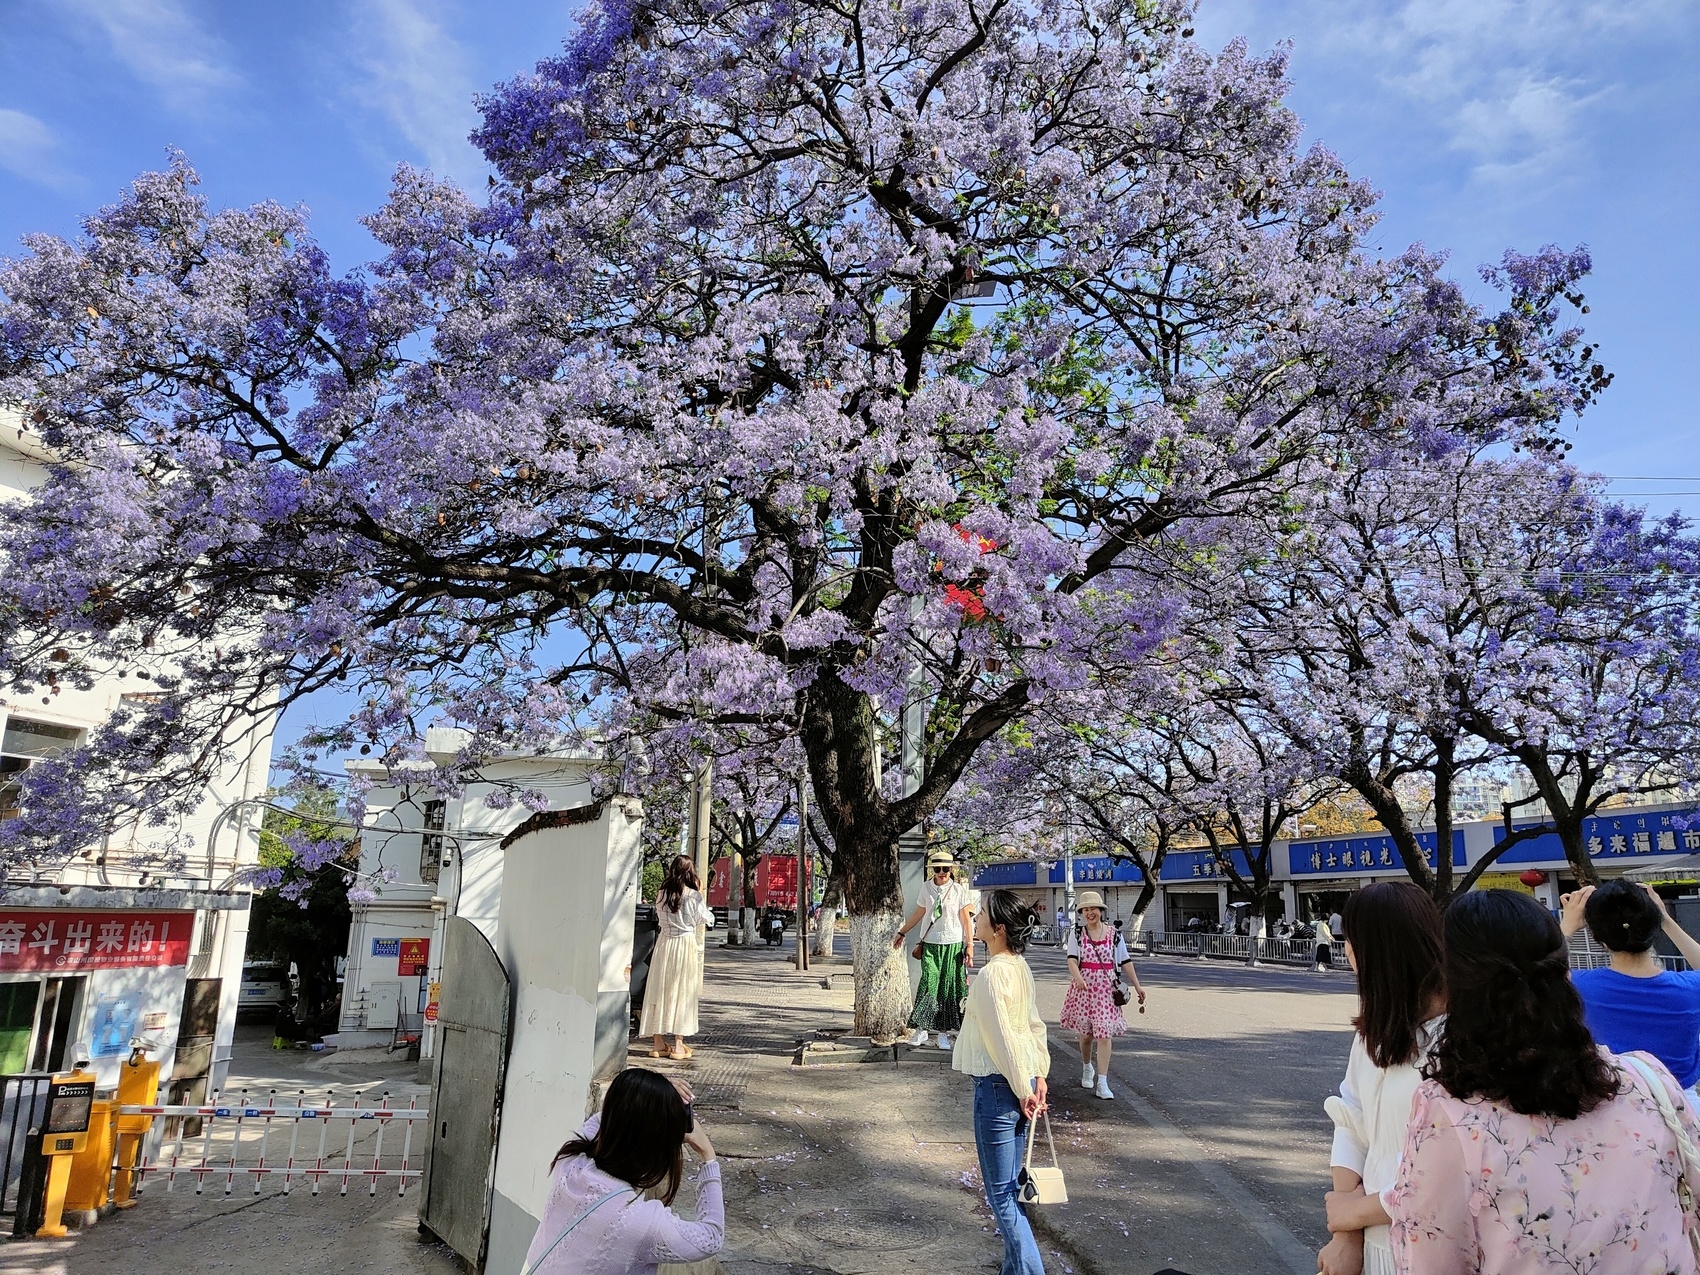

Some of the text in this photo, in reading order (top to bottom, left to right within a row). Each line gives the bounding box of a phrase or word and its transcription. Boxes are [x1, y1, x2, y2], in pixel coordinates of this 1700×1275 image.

[1587, 828, 1700, 856] 多来福超市
[1310, 846, 1432, 871] 博士眼视光心
